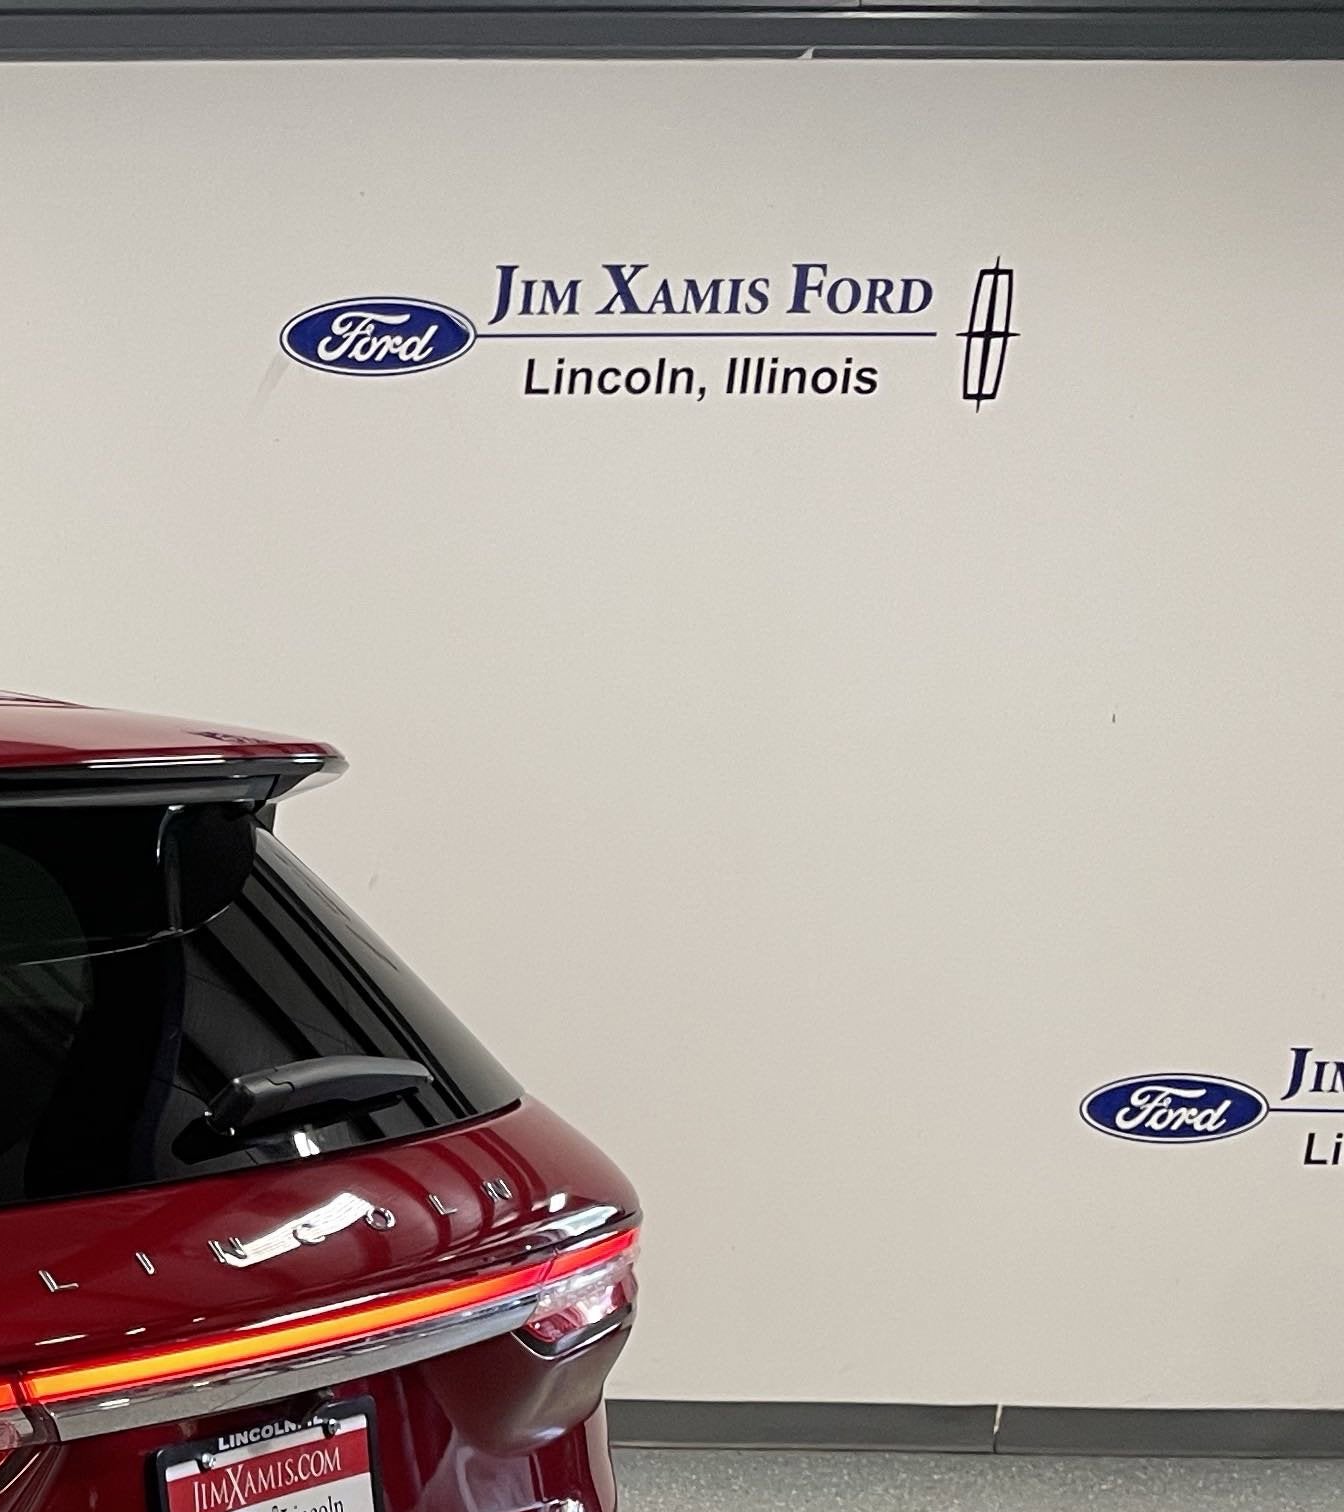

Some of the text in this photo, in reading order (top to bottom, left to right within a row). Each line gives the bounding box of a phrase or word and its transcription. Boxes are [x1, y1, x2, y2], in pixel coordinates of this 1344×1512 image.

[488, 263, 933, 325] JIM XAMIS FORD
[318, 311, 438, 361] Ford
[525, 357, 878, 401] Lincoln, Illinois
[1115, 1085, 1232, 1131] Ford
[38, 1177, 513, 1293] LINCOLN
